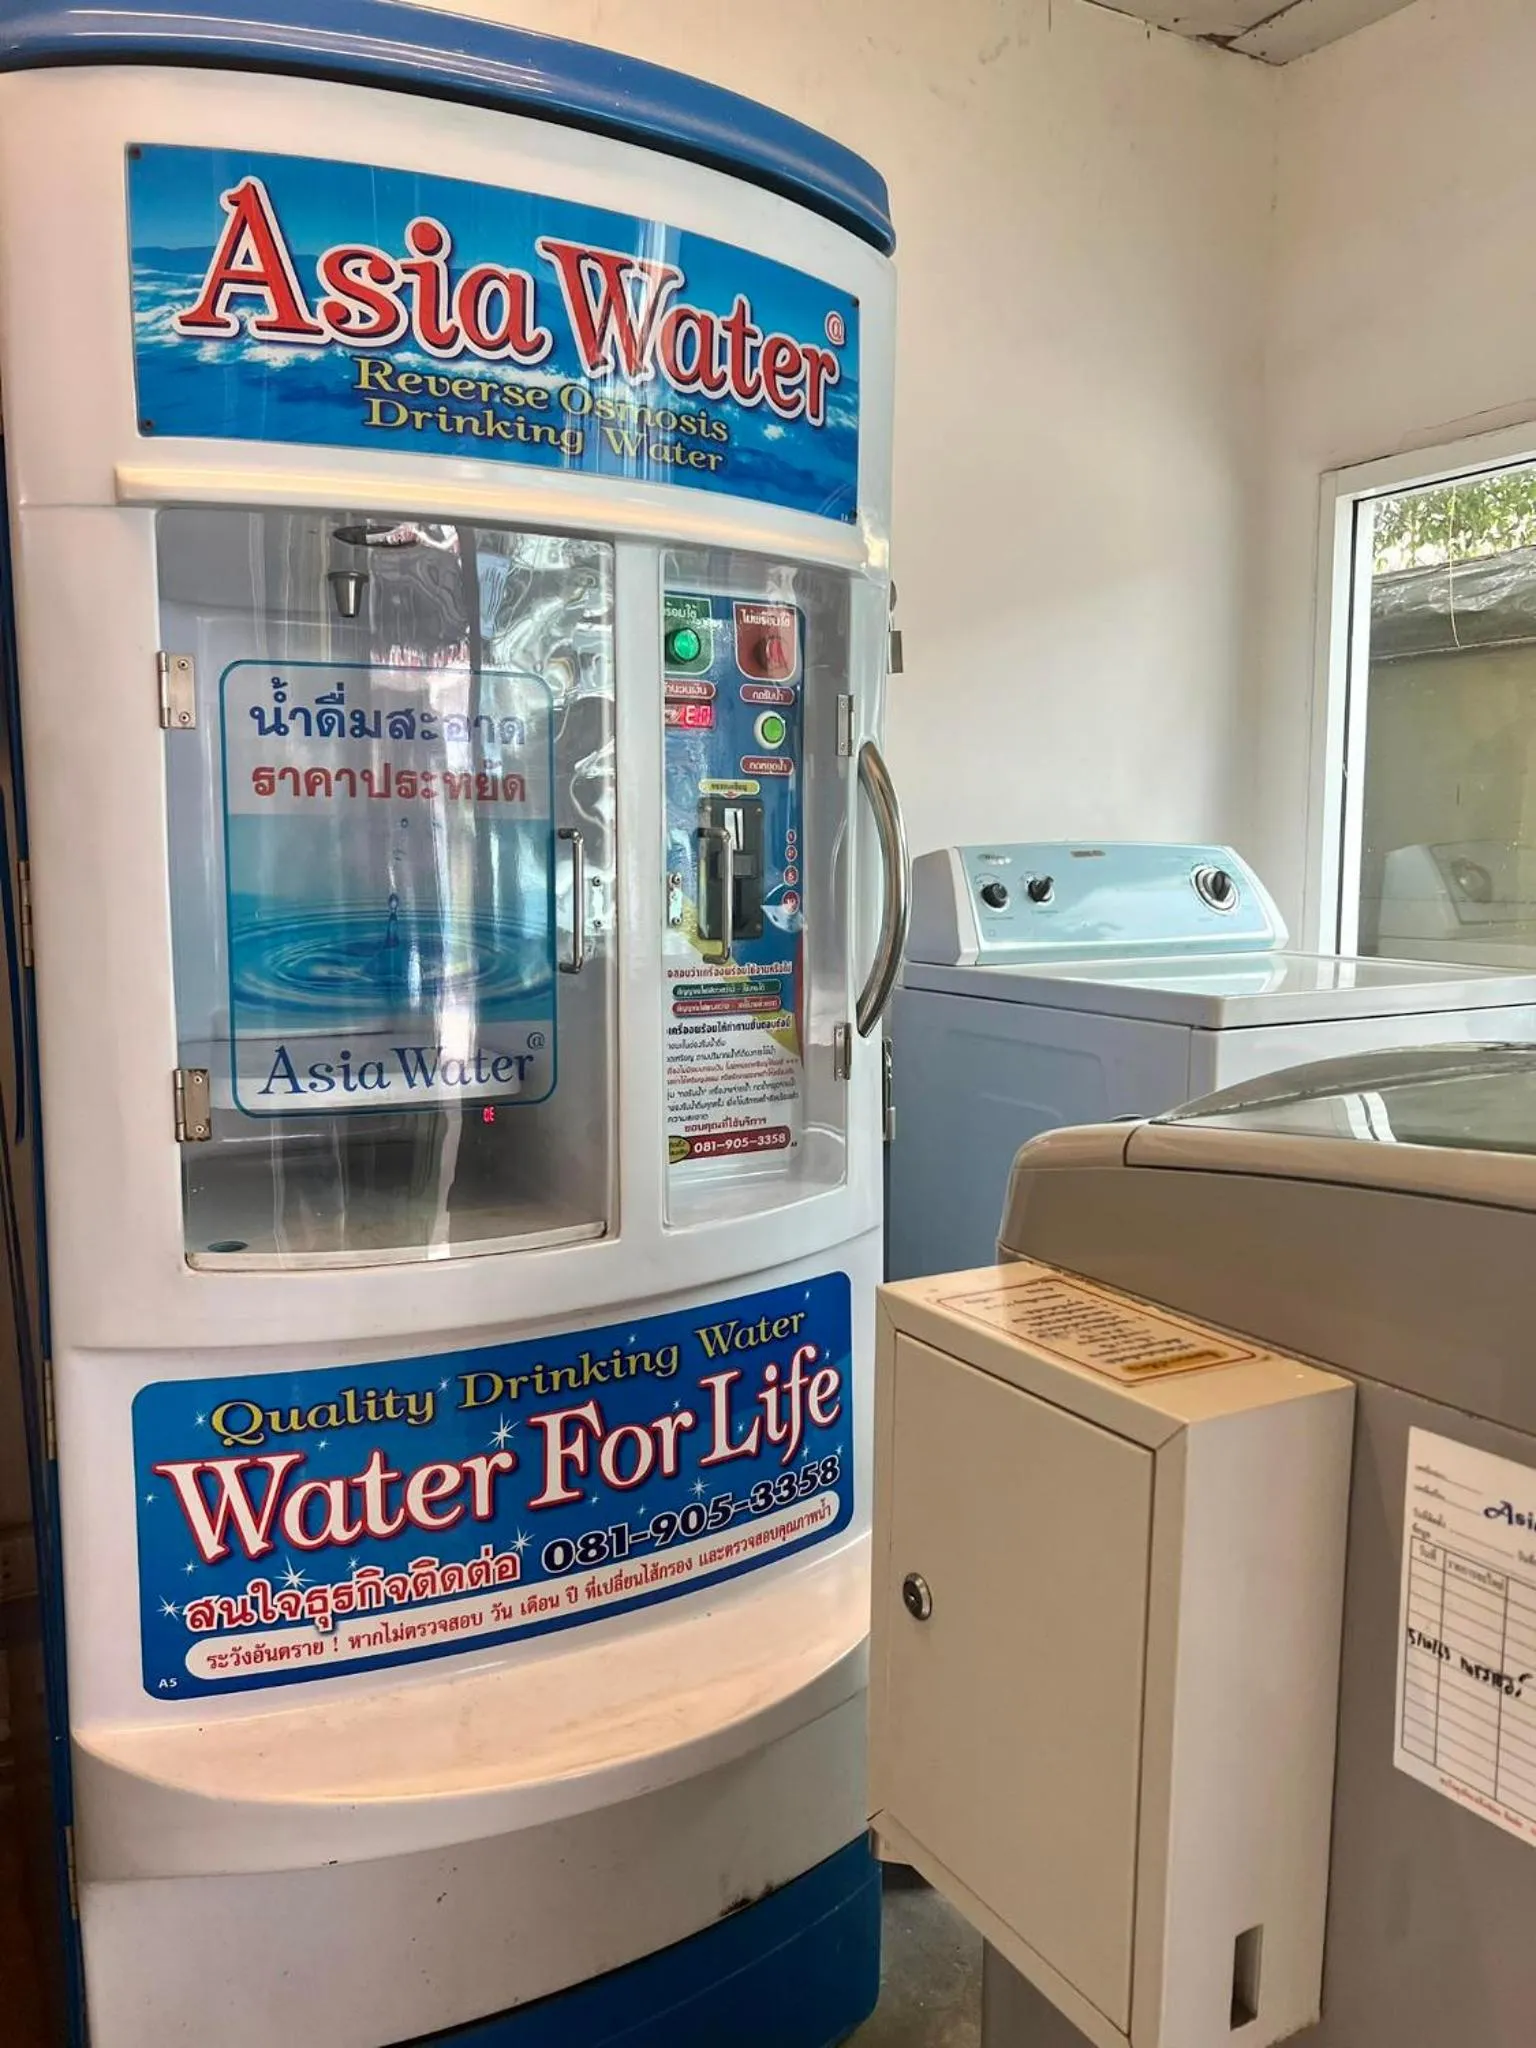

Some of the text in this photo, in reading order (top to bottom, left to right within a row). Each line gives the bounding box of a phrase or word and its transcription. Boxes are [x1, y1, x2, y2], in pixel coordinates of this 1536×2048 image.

[178, 177, 550, 360] Asia
[538, 236, 840, 424] Water
[355, 357, 729, 443] Reverse Osmosis
[364, 398, 724, 472] Drinking Water
[249, 676, 528, 747] น้ำดื่มสะอาด
[252, 759, 528, 803] ราคาประหยัด
[257, 1045, 391, 1096] Asia
[391, 1043, 534, 1087] Water
[694, 1133, 786, 1153] 081-905-3358
[210, 1309, 805, 1449] Quality Drinking Water
[153, 1339, 841, 1566] Water For Life
[183, 1455, 841, 1633] สนใจธุรกิจติดต่อ 081-905-3358
[207, 1641, 325, 1670] ระวังอันตราย
[348, 1611, 484, 1651] หากไม่ตรวจสอบ
[491, 1602, 513, 1622] วัน
[520, 1593, 560, 1616] เดือน
[566, 1586, 579, 1605] ปี
[585, 1557, 694, 1600] ที่เปลี่ยนไส้กรอง
[699, 1498, 832, 1565] และตรวจสอบคุณภาพน้ำ
[159, 1677, 178, 1689] A5
